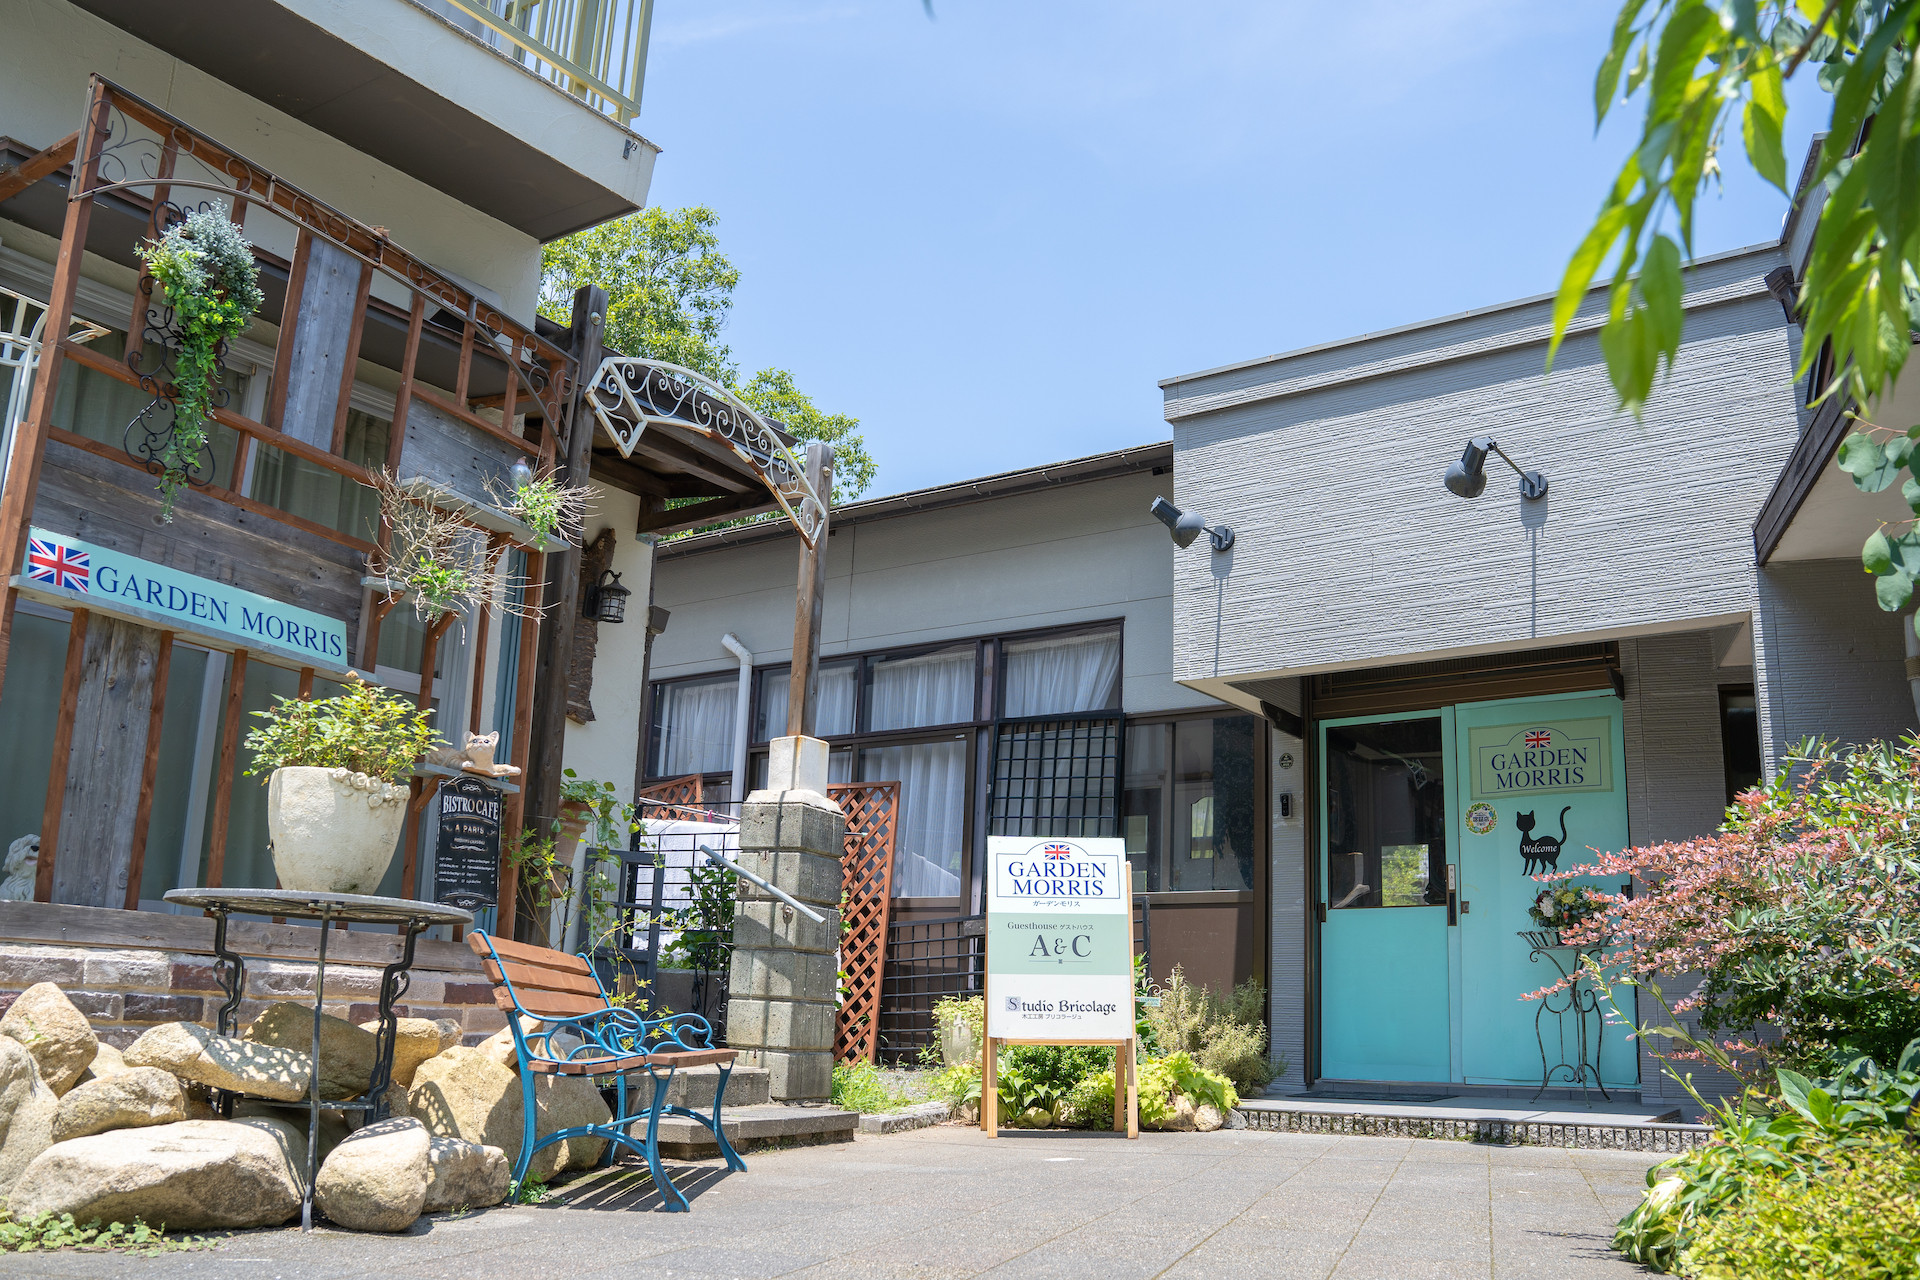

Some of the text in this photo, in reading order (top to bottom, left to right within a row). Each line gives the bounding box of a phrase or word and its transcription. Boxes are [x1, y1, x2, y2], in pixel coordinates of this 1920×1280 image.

[96, 566, 342, 657] GARDEN MORRIS
[1491, 747, 1588, 790] GARDEN MORRIS
[442, 795, 475, 813] BISTRO
[463, 825, 485, 835] PARIS
[1522, 842, 1558, 854] Welcome
[1008, 861, 1107, 878] GARDEN
[1013, 879, 1104, 897] MORRIS
[1007, 921, 1058, 930] Guesthouse
[1029, 934, 1092, 958] A & C
[1007, 997, 1117, 1016] Studio Bricolage
